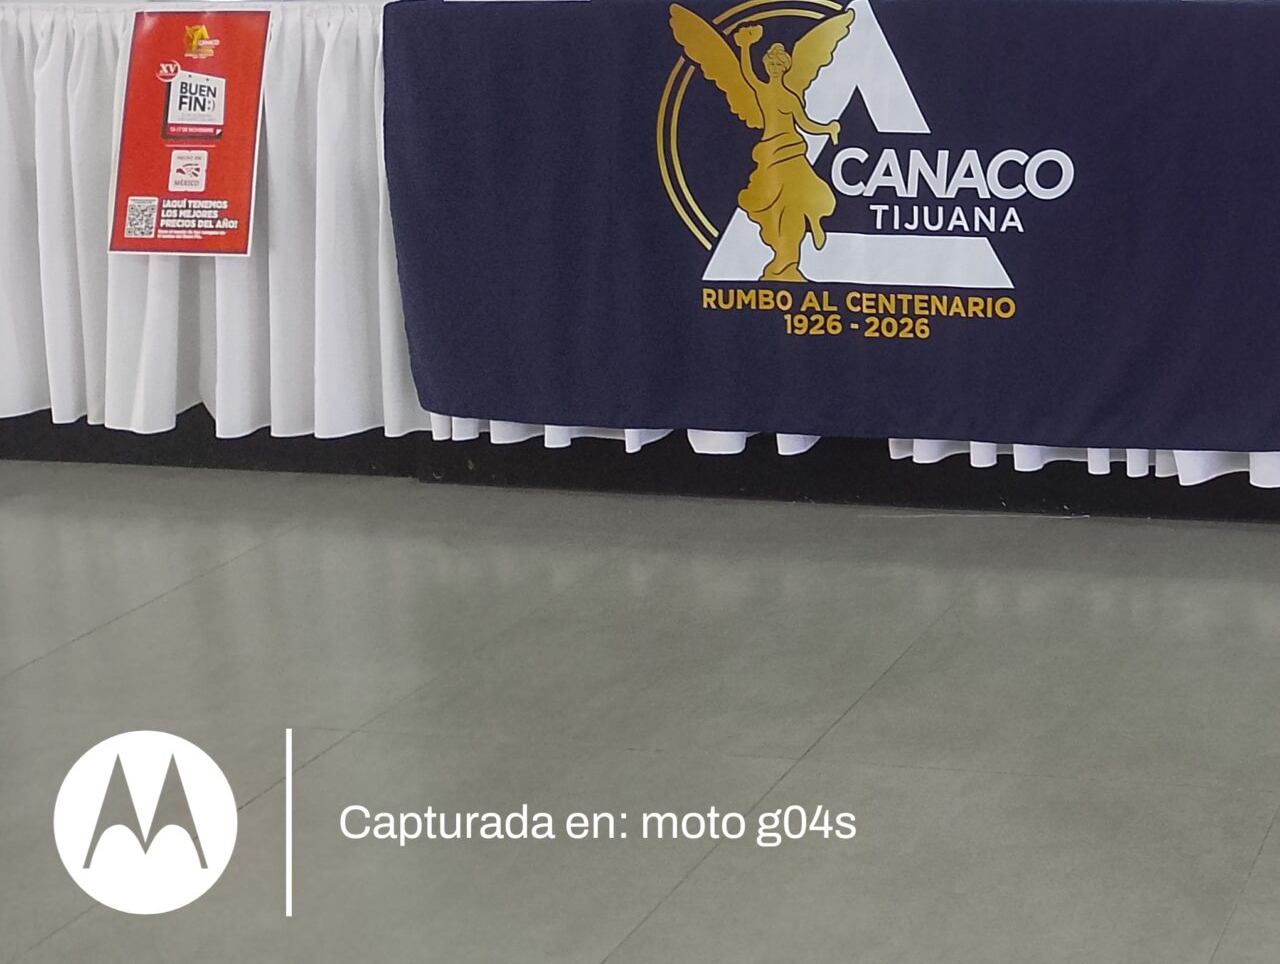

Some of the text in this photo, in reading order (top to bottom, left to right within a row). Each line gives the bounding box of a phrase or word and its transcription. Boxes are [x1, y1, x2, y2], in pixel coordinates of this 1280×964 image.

[158, 63, 177, 74] XV
[180, 81, 217, 98] BUEN
[830, 147, 1076, 200] CANACO
[187, 200, 228, 209] TENEMOS
[161, 209, 218, 219] LOS MEJORES
[869, 204, 1025, 233] TIJUANA
[160, 218, 238, 229] PRECIOS DEL AÑO!
[702, 287, 1017, 320] RUMBO AL CENTENARIO
[784, 313, 843, 335] 1926
[864, 316, 931, 339] 2026
